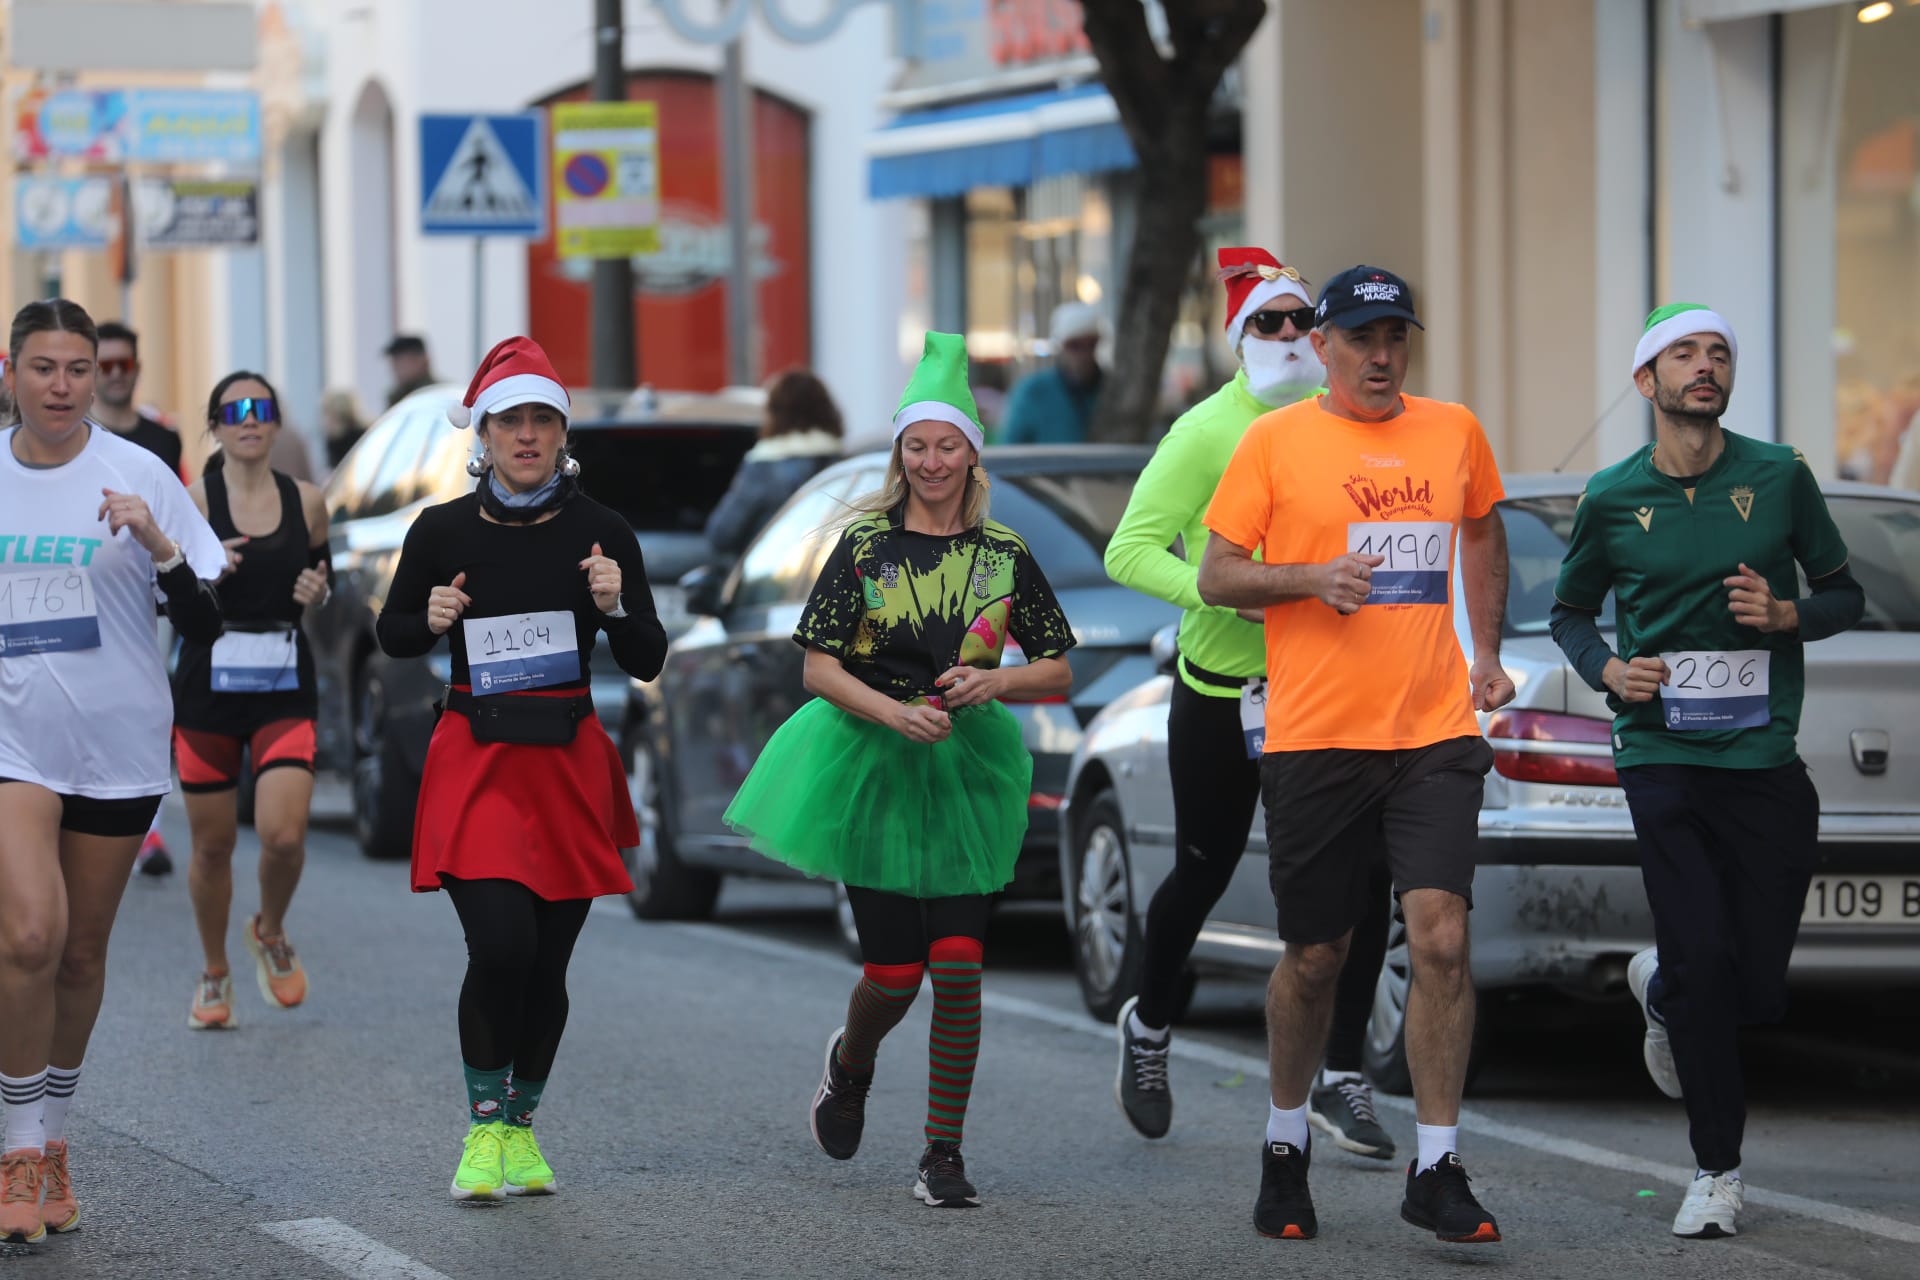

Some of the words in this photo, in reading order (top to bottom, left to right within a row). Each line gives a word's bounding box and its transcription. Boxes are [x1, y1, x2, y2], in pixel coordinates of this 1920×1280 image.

[1354, 285, 1400, 297] AMERICAN
[1364, 292, 1395, 302] MAGIC
[1342, 476, 1434, 518] World
[0, 535, 103, 567] TLEET
[1357, 533, 1441, 569] 1190
[0, 575, 86, 620] 1769
[483, 625, 550, 656] 1104
[1676, 657, 1756, 690] 206
[1815, 881, 1882, 918] 109
